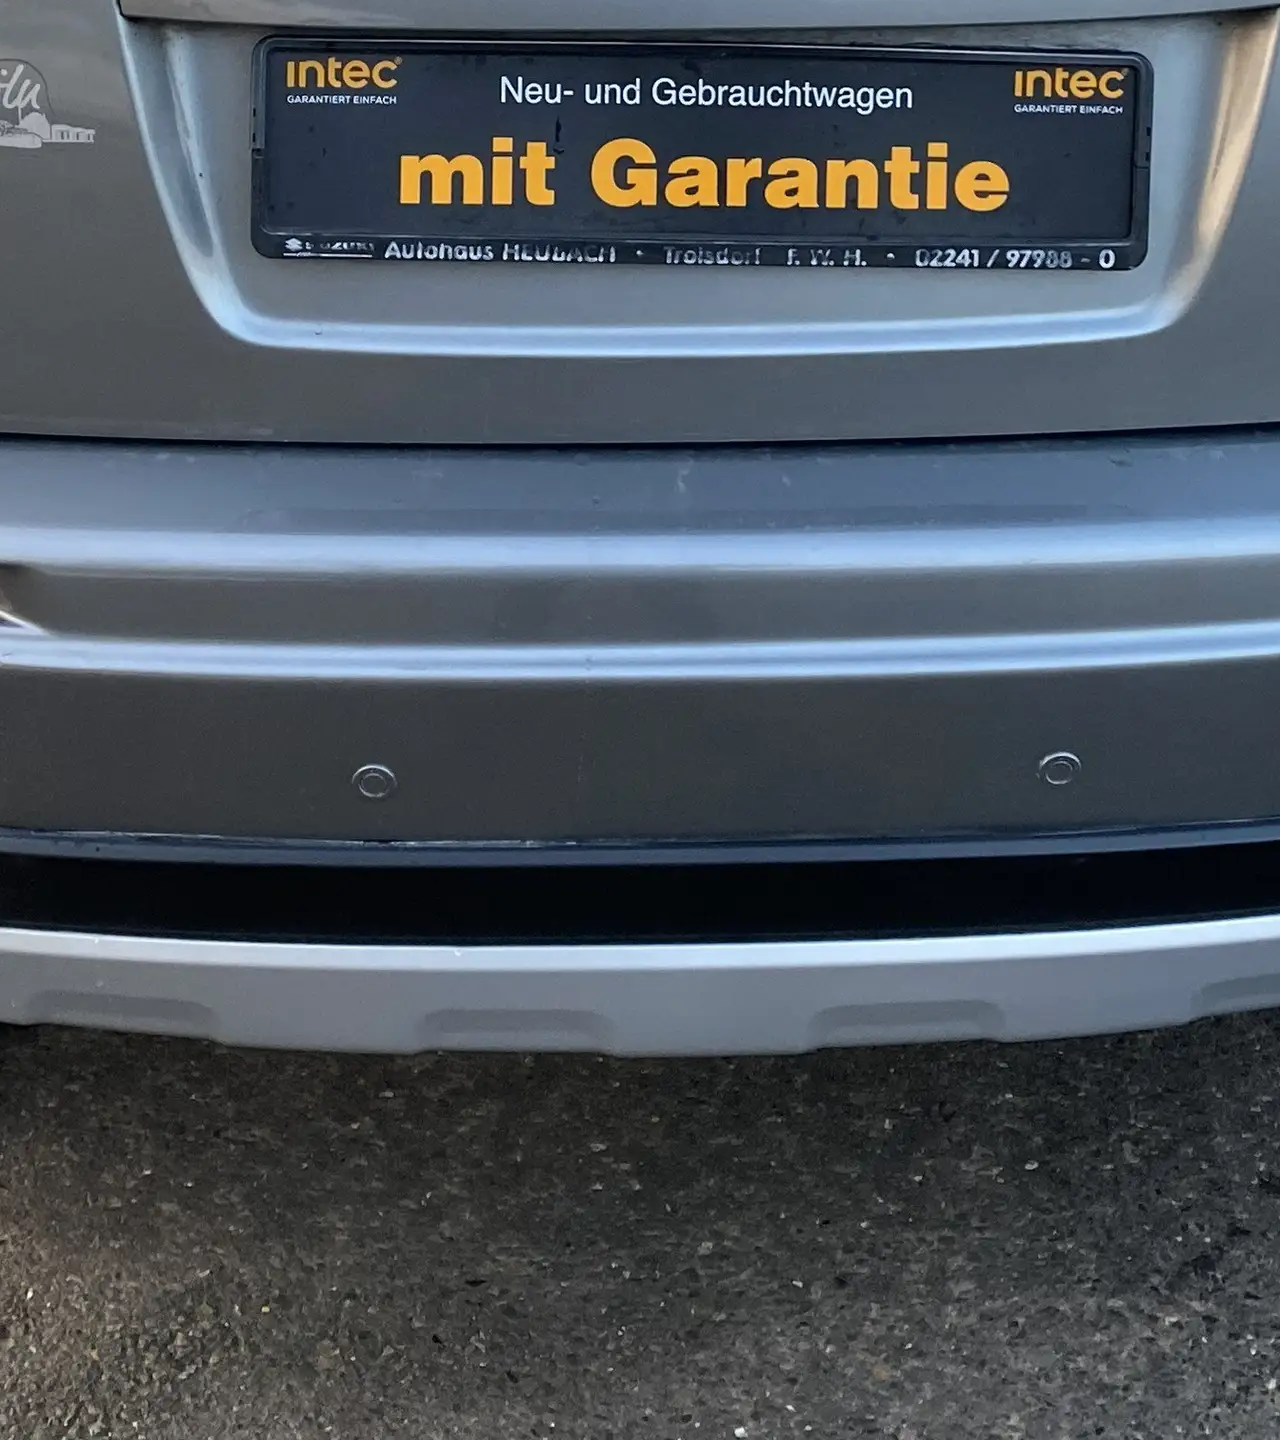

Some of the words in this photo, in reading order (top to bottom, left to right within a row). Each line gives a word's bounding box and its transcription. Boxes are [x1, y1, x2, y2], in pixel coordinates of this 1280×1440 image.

[285, 56, 399, 90] intec
[1013, 66, 1125, 100] intec
[286, 94, 350, 106] GARANTIERT
[353, 94, 397, 106] EINFACH
[499, 75, 575, 106] Neu-
[584, 78, 641, 107] und
[651, 77, 913, 116] Gebrauchtwagen
[1013, 103, 1077, 115] GARANTIERT
[1079, 104, 1124, 115] EINFACH
[399, 136, 556, 207] mit
[590, 137, 1011, 213] Garantie
[383, 240, 494, 261] Autohaus
[915, 249, 980, 268] 02241
[1098, 249, 1117, 269] 0
